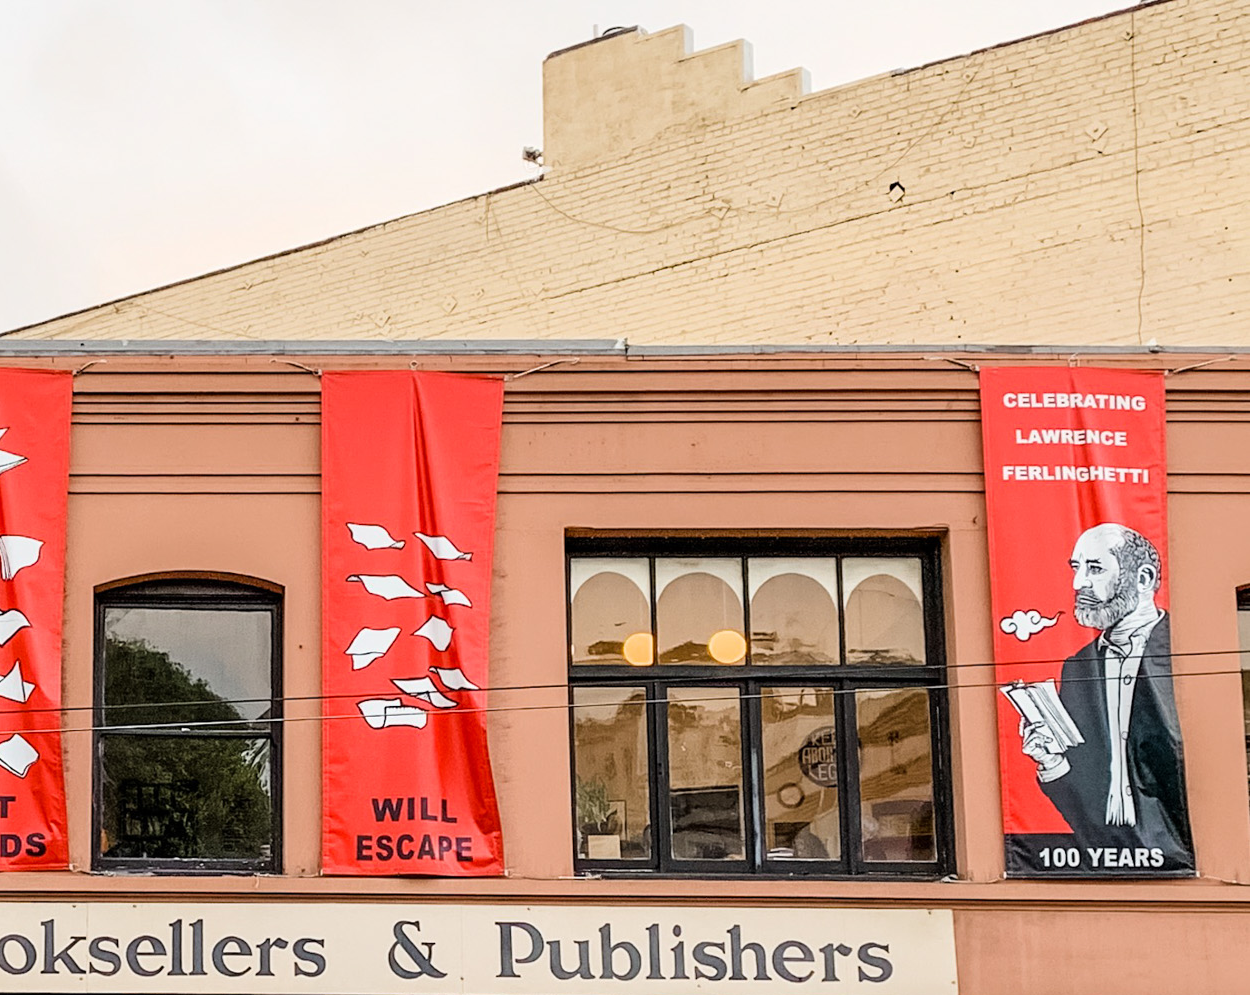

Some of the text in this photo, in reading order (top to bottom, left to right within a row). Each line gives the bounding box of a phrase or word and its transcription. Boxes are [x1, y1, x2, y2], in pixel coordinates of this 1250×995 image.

[1003, 393, 1146, 411] CELEBRATING
[1015, 429, 1128, 446] LAWRENCE
[1002, 465, 1150, 484] FERLINGHETTI
[810, 731, 836, 747] KE
[802, 746, 835, 765] ABOR
[807, 763, 837, 781] LEG
[372, 797, 458, 823] WILL
[356, 834, 474, 862] ESCAPE
[1039, 847, 1165, 868] 100 YEARS
[388, 920, 448, 979] &
[495, 921, 894, 983] Publishers
